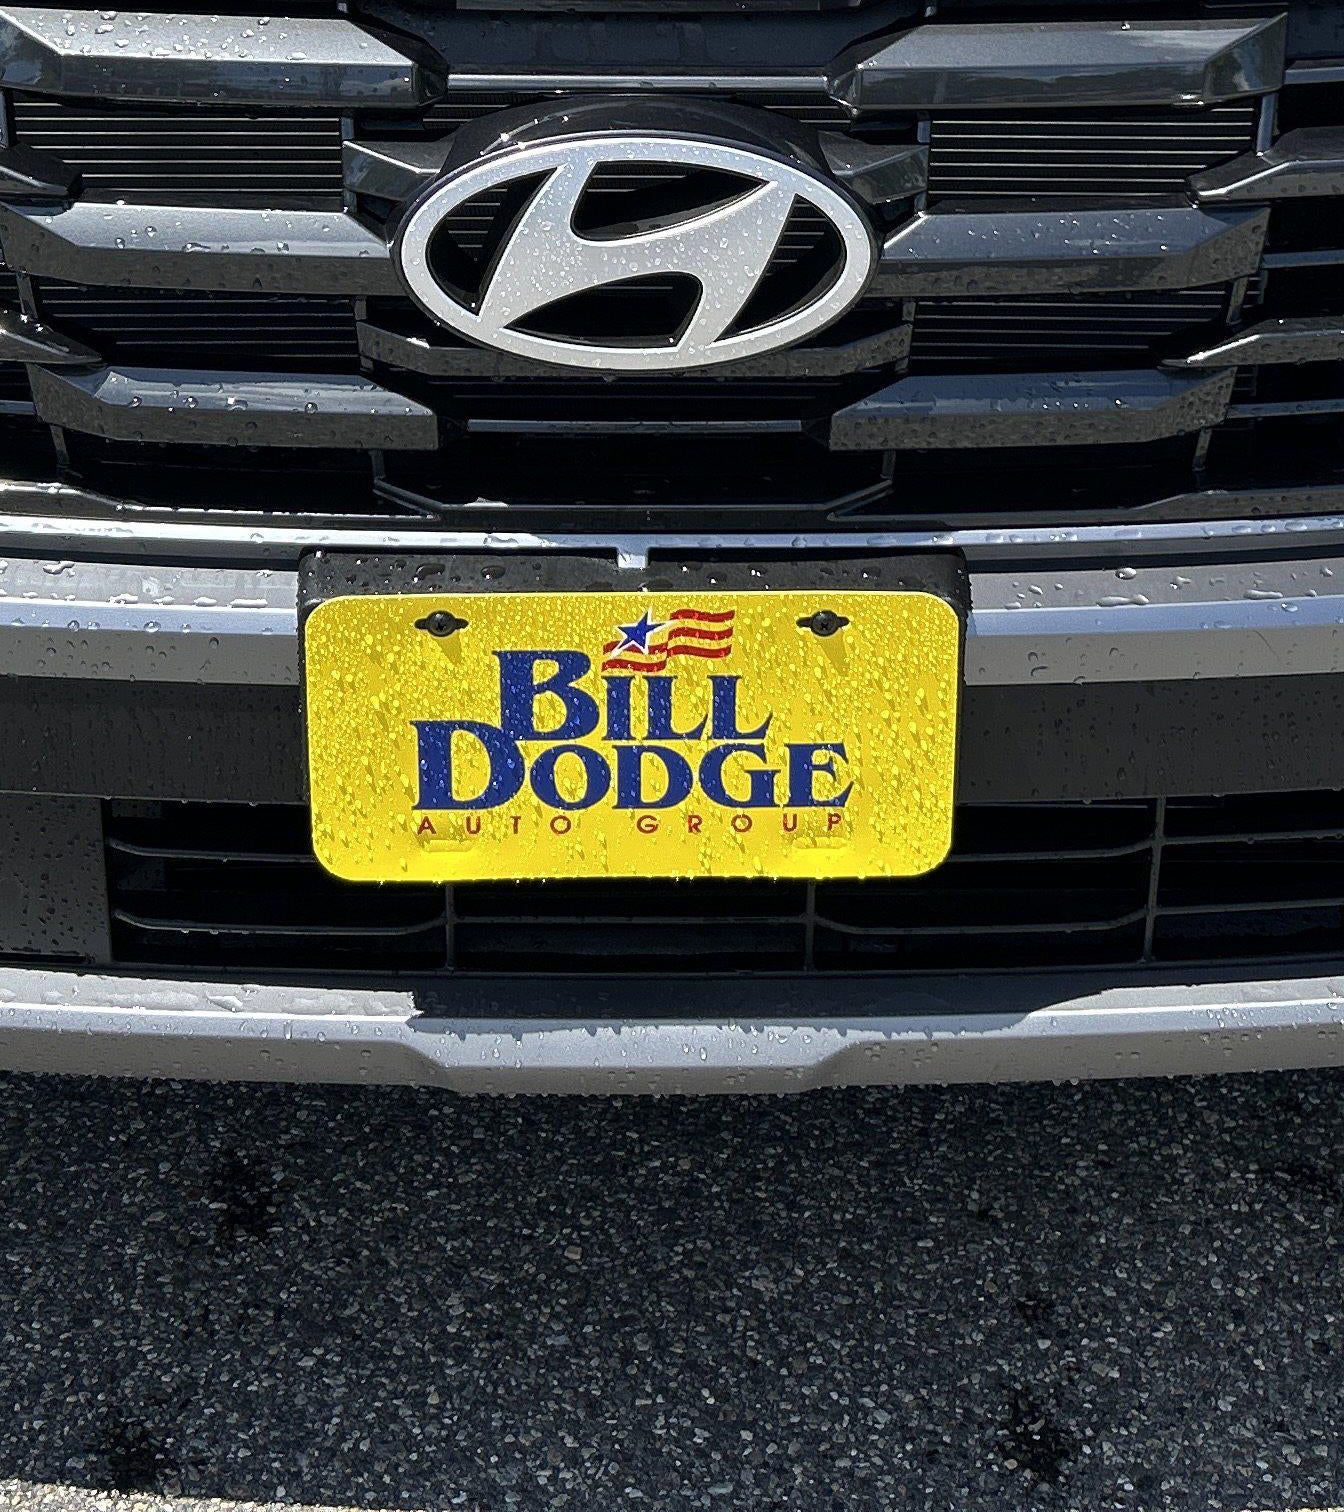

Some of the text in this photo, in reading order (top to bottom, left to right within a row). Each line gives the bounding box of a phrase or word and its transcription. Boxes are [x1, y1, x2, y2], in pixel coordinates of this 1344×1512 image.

[491, 649, 774, 742] BILL
[410, 719, 857, 812] DODGE
[417, 813, 843, 836] AUTO GROUP
